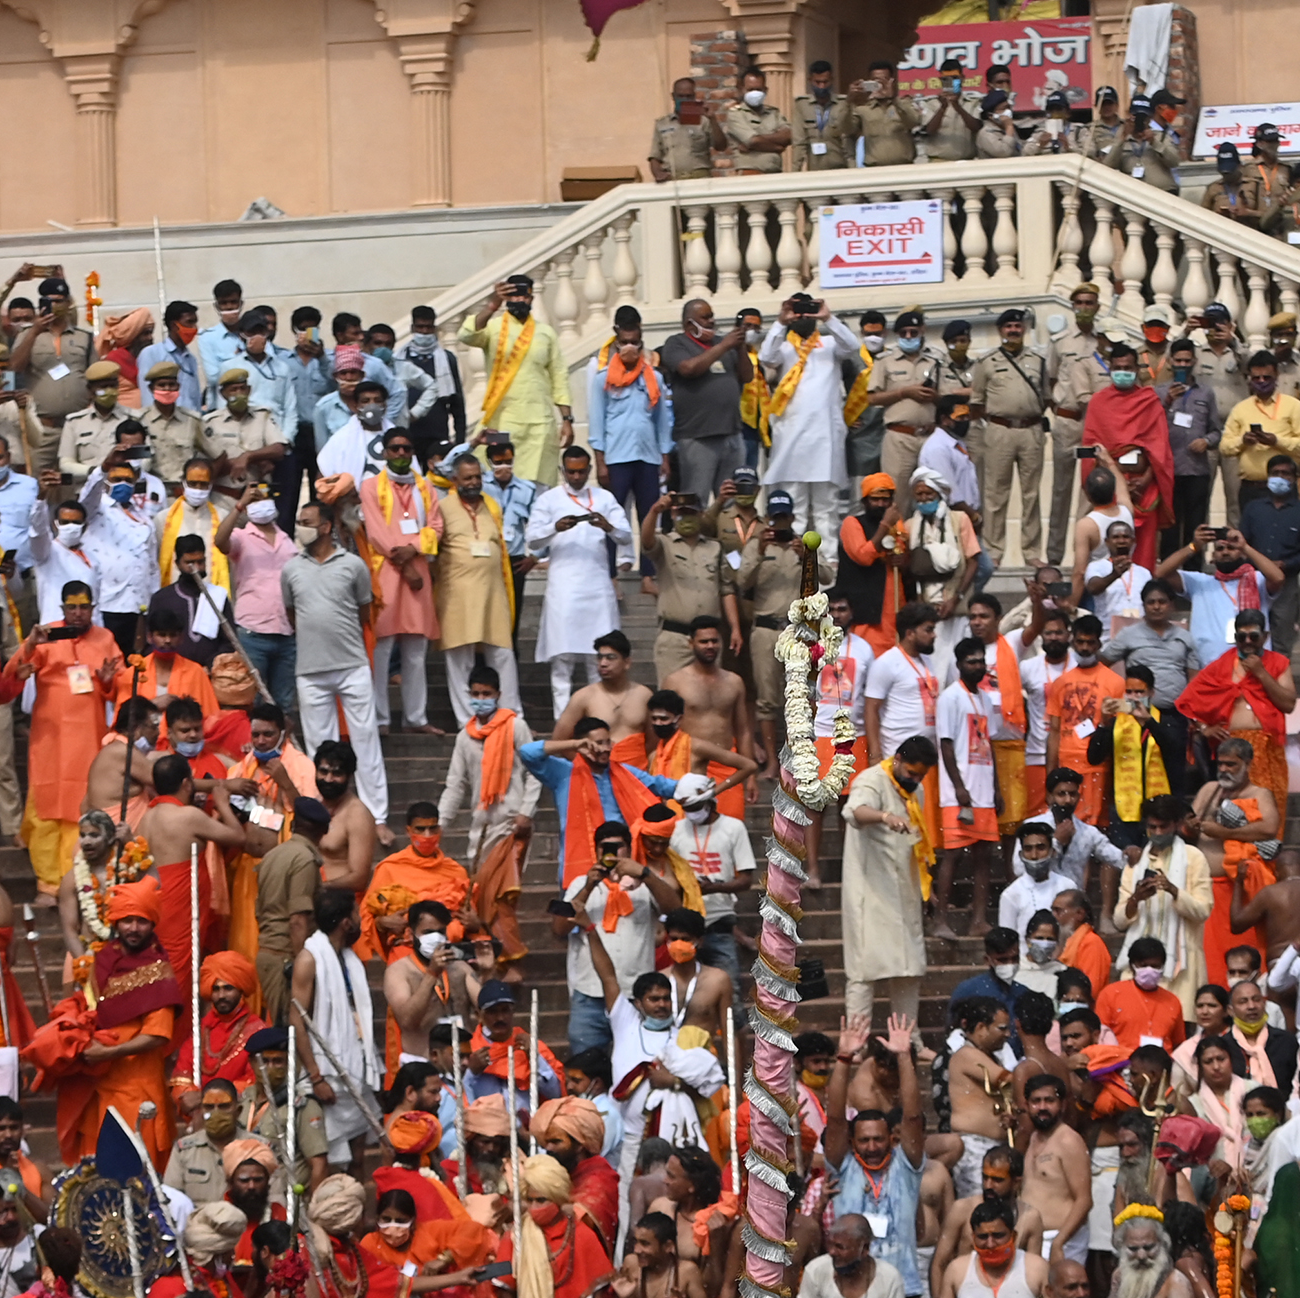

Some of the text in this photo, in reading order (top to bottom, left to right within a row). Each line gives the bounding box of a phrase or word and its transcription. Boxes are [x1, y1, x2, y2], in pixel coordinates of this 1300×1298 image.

[991, 27, 1090, 67] भोज
[1205, 122, 1242, 138] जाने
[835, 216, 925, 239] निकासी
[847, 238, 913, 256] EXIT
